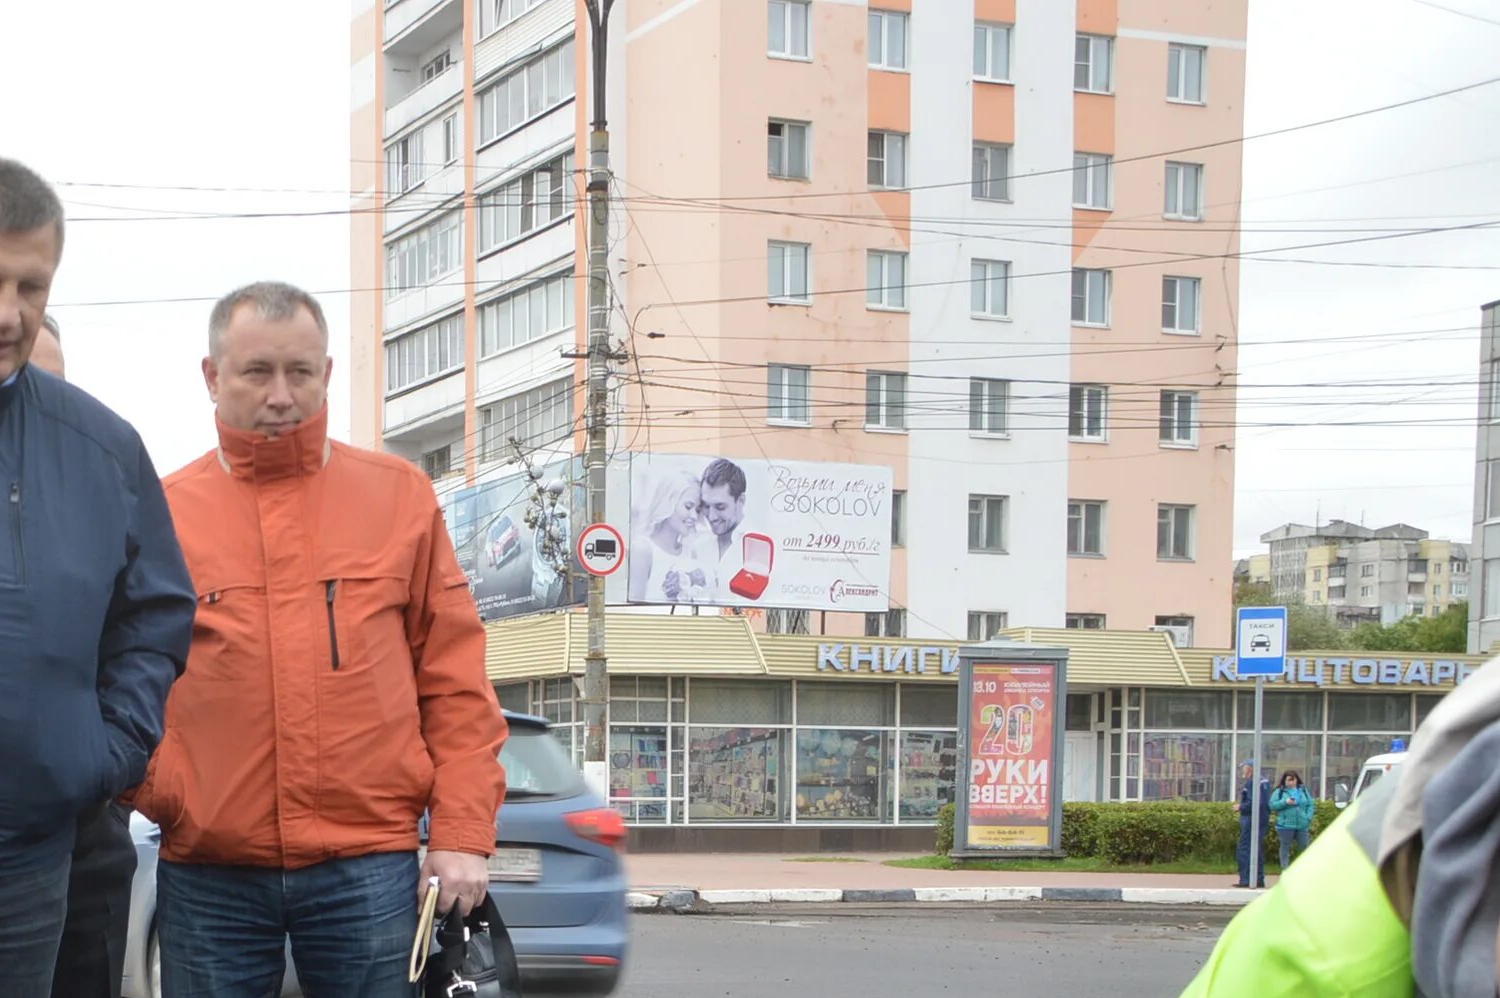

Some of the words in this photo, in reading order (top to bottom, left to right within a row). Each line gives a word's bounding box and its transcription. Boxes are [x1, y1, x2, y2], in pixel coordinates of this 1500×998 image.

[783, 494, 882, 516] SOKOLOV
[782, 536, 802, 548] от
[806, 533, 841, 549] 2499
[781, 584, 826, 595] SOKOLOV
[817, 642, 960, 673] КНИГИ
[978, 704, 1033, 755] 20
[969, 758, 1048, 785] РУКИ
